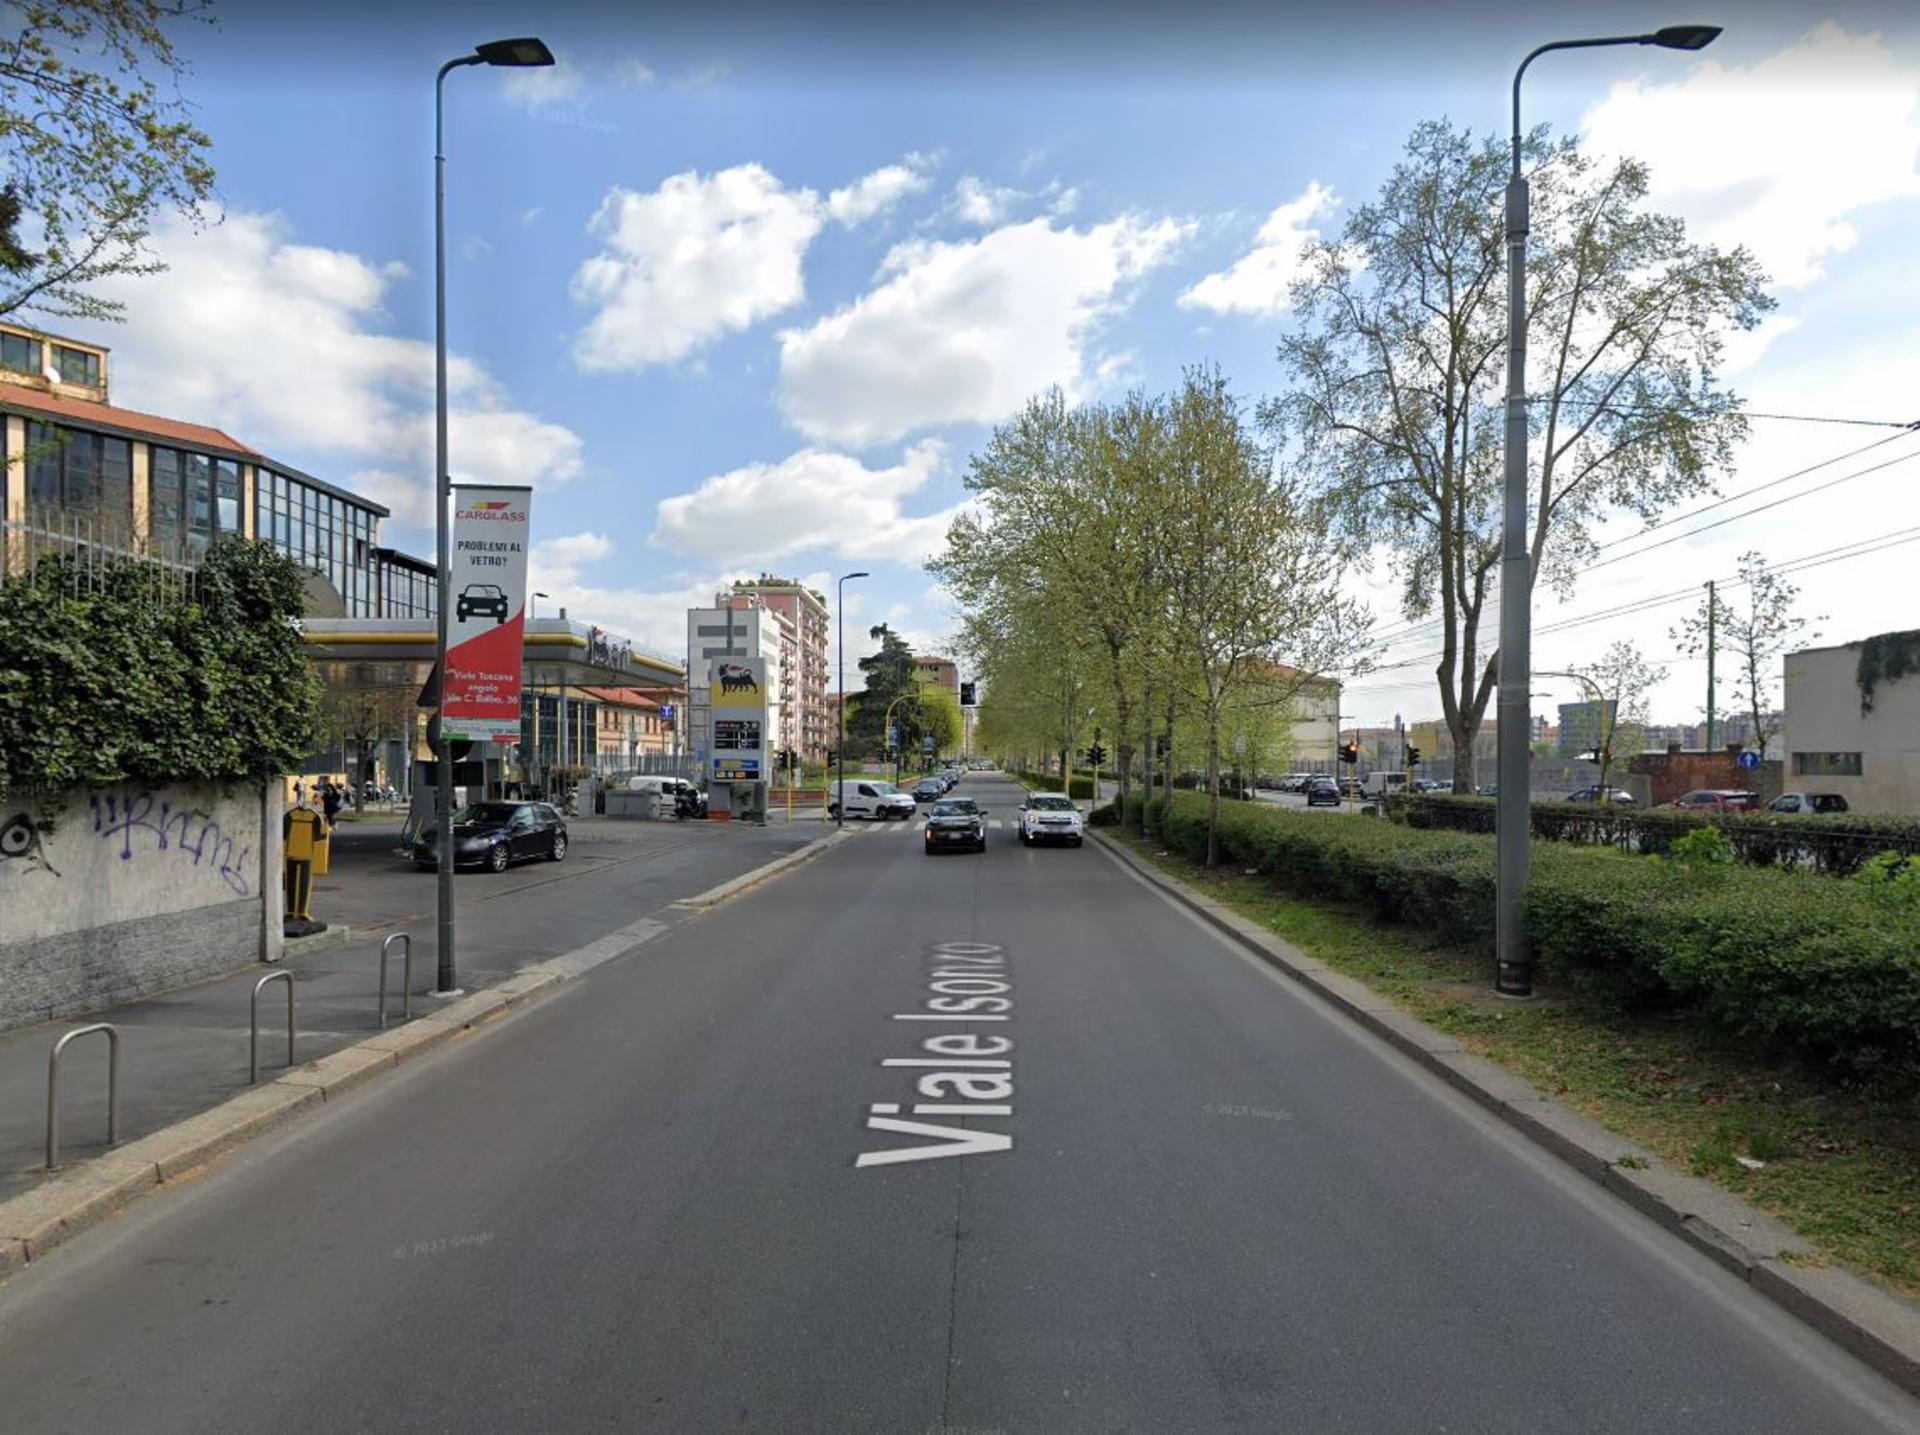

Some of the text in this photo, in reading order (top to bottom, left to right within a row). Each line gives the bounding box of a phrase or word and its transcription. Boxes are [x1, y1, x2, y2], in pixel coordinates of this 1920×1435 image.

[456, 509, 526, 522] CARGLASS
[457, 540, 522, 553] PROBLEMI AL
[469, 555, 508, 567] VETRO?
